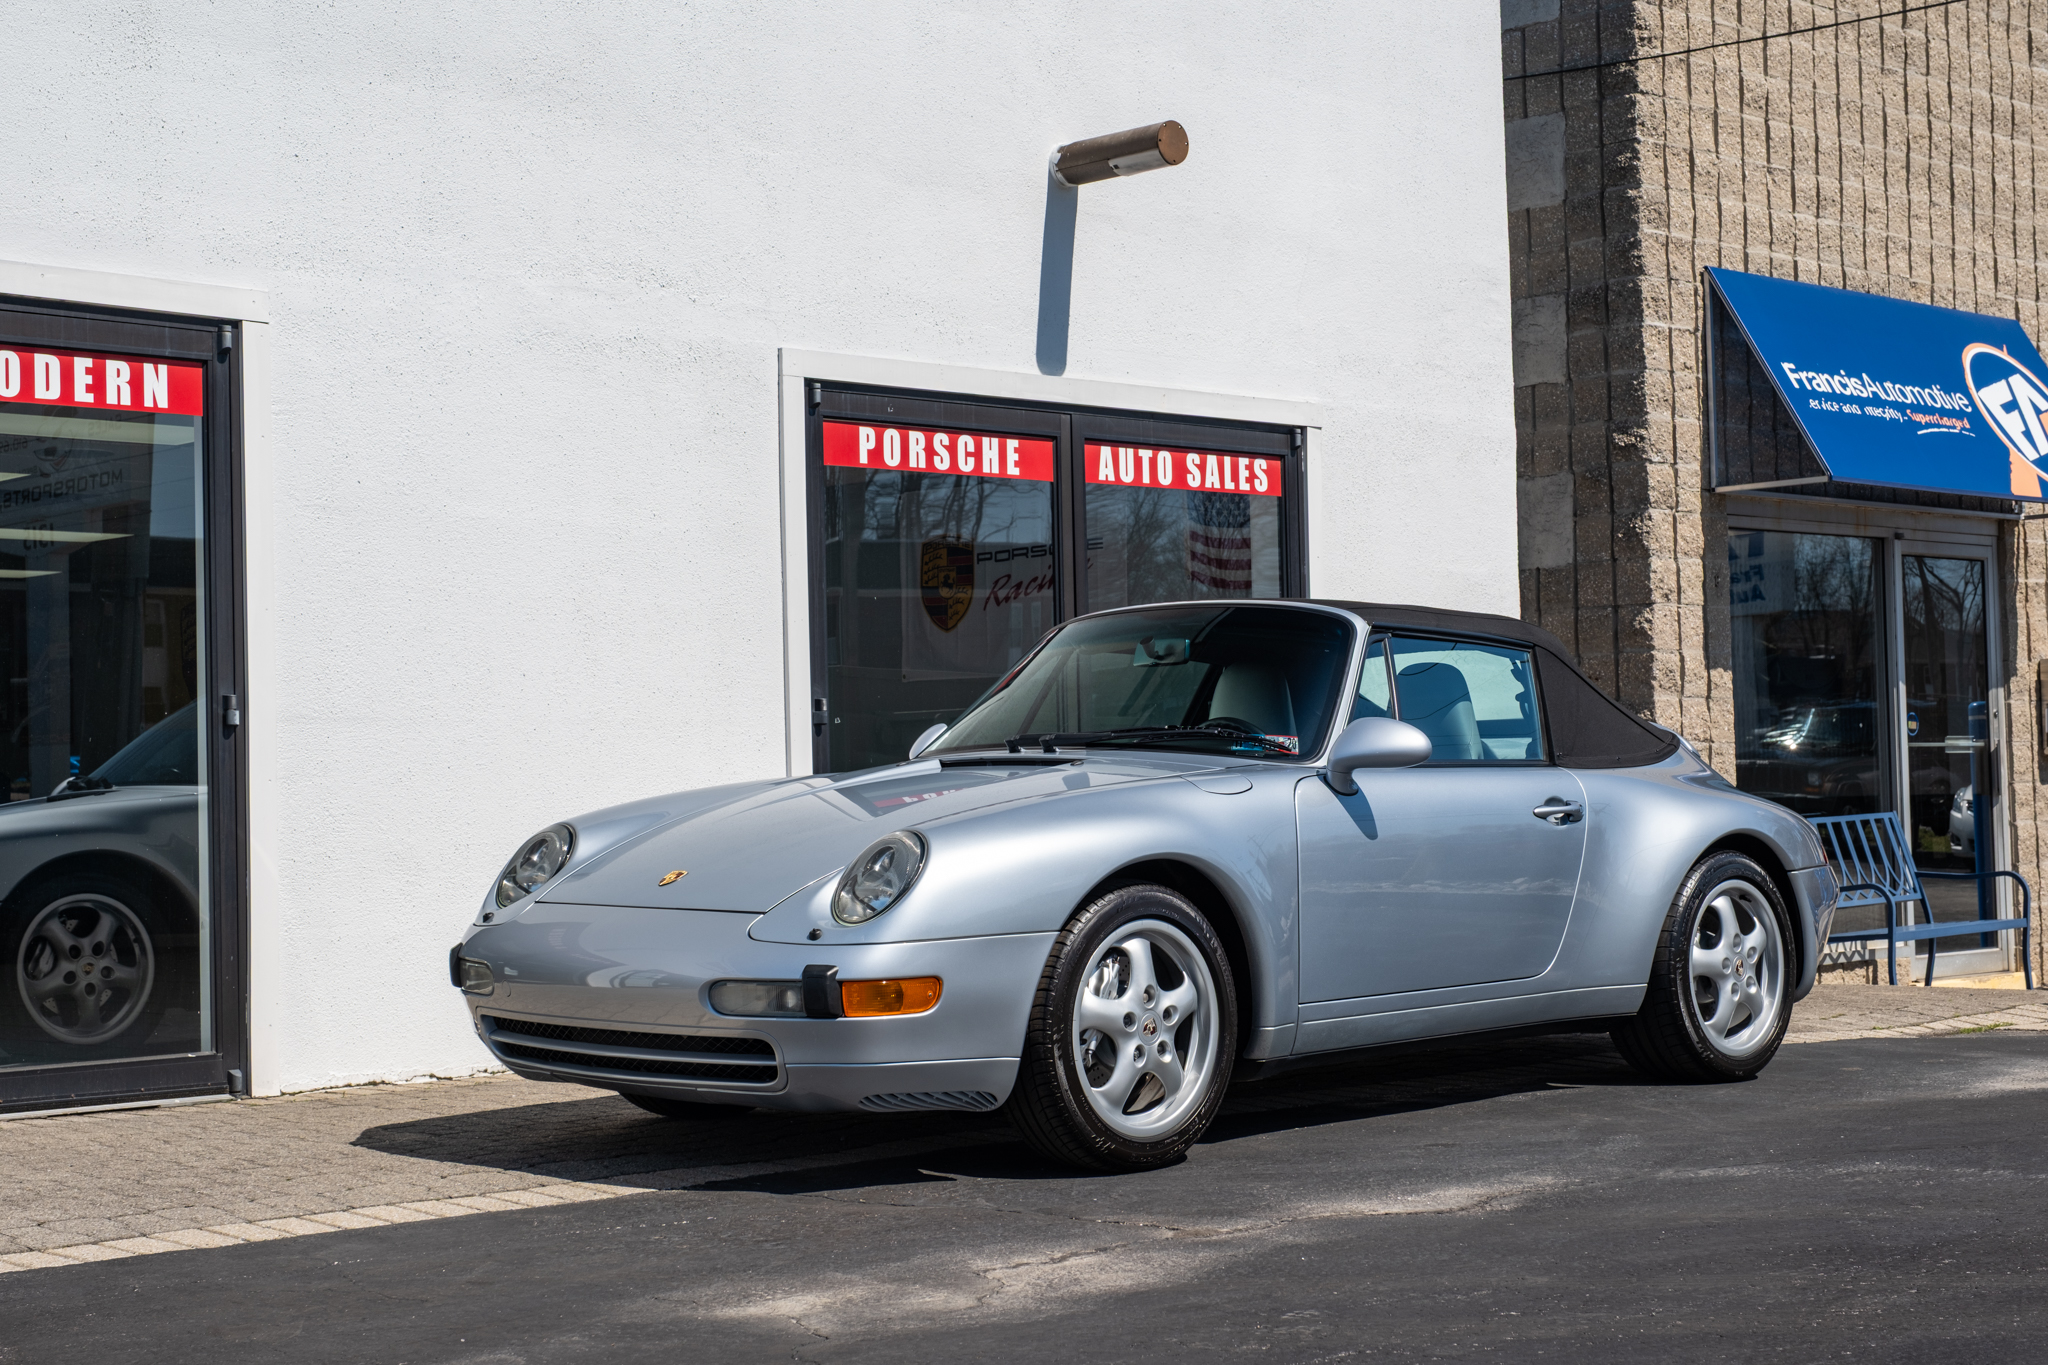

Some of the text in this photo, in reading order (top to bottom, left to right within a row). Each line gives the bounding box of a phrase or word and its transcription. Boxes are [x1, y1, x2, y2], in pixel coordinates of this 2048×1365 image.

[0, 350, 168, 408] ODERN
[859, 426, 1020, 476] PORSCHE
[1098, 446, 1269, 492] AUTO SALES
